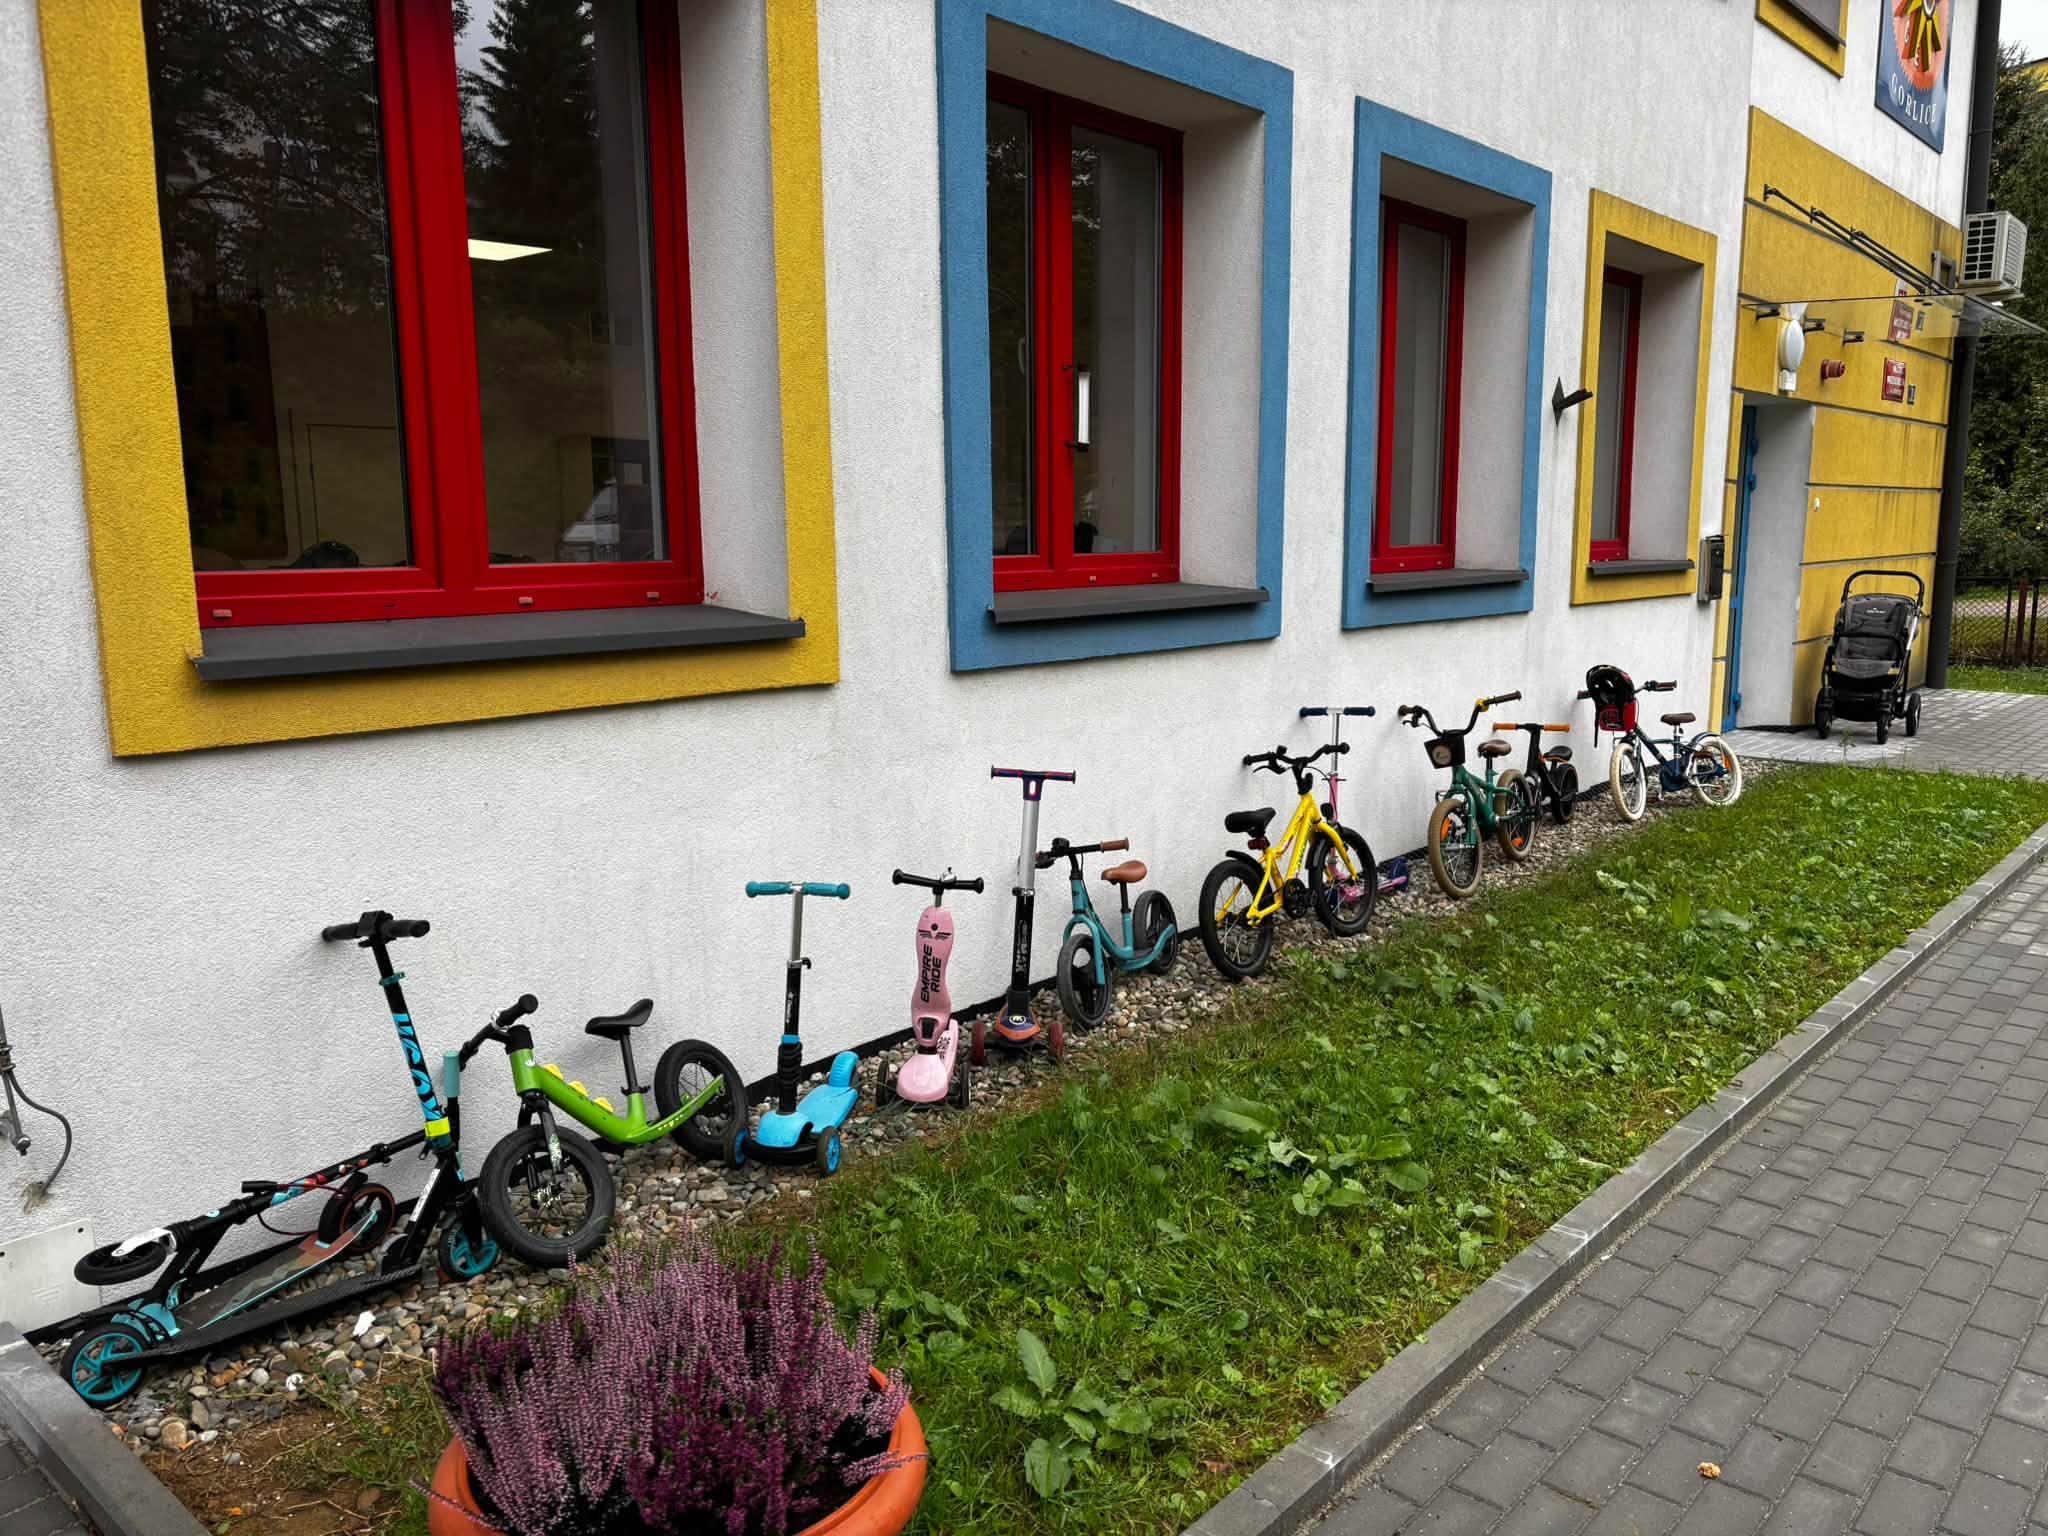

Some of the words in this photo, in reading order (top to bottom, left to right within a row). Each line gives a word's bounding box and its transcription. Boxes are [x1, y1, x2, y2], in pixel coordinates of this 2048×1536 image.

[1891, 72, 1937, 125] GORLICE
[920, 943, 933, 1003] EMPIRE
[930, 955, 942, 993] RIDE
